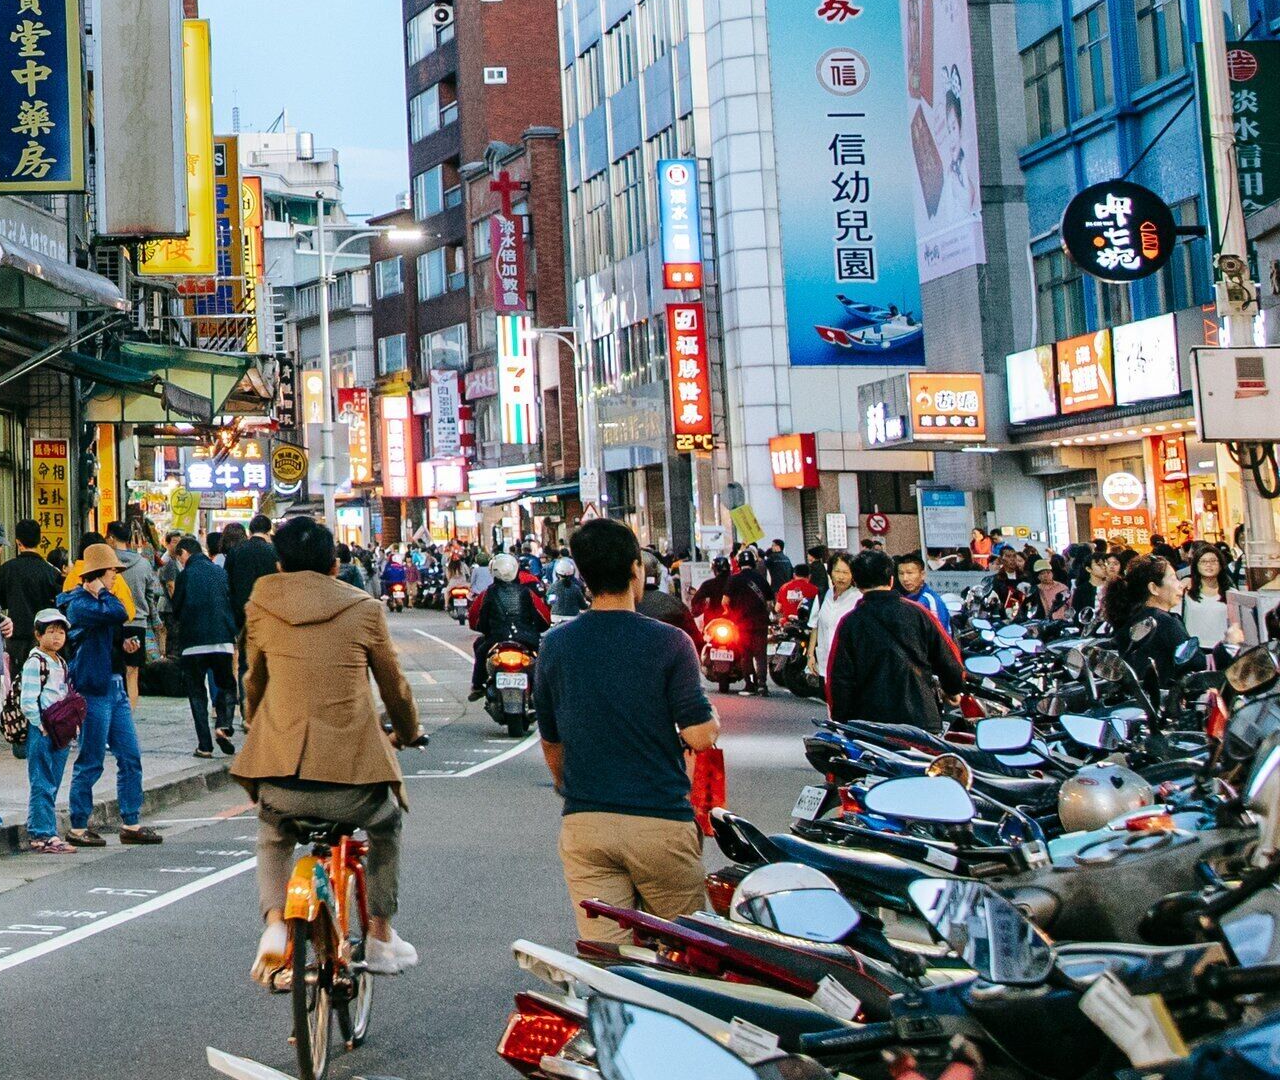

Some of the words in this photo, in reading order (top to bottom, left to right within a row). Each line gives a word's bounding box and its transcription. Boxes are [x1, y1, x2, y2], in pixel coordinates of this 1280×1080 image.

[826, 111, 877, 281] 一信幼兒園
[499, 220, 520, 306] 淡水倍加教會
[38, 462, 65, 480] 命相
[37, 487, 65, 505] 占卦
[1111, 516, 1145, 526] 古早味
